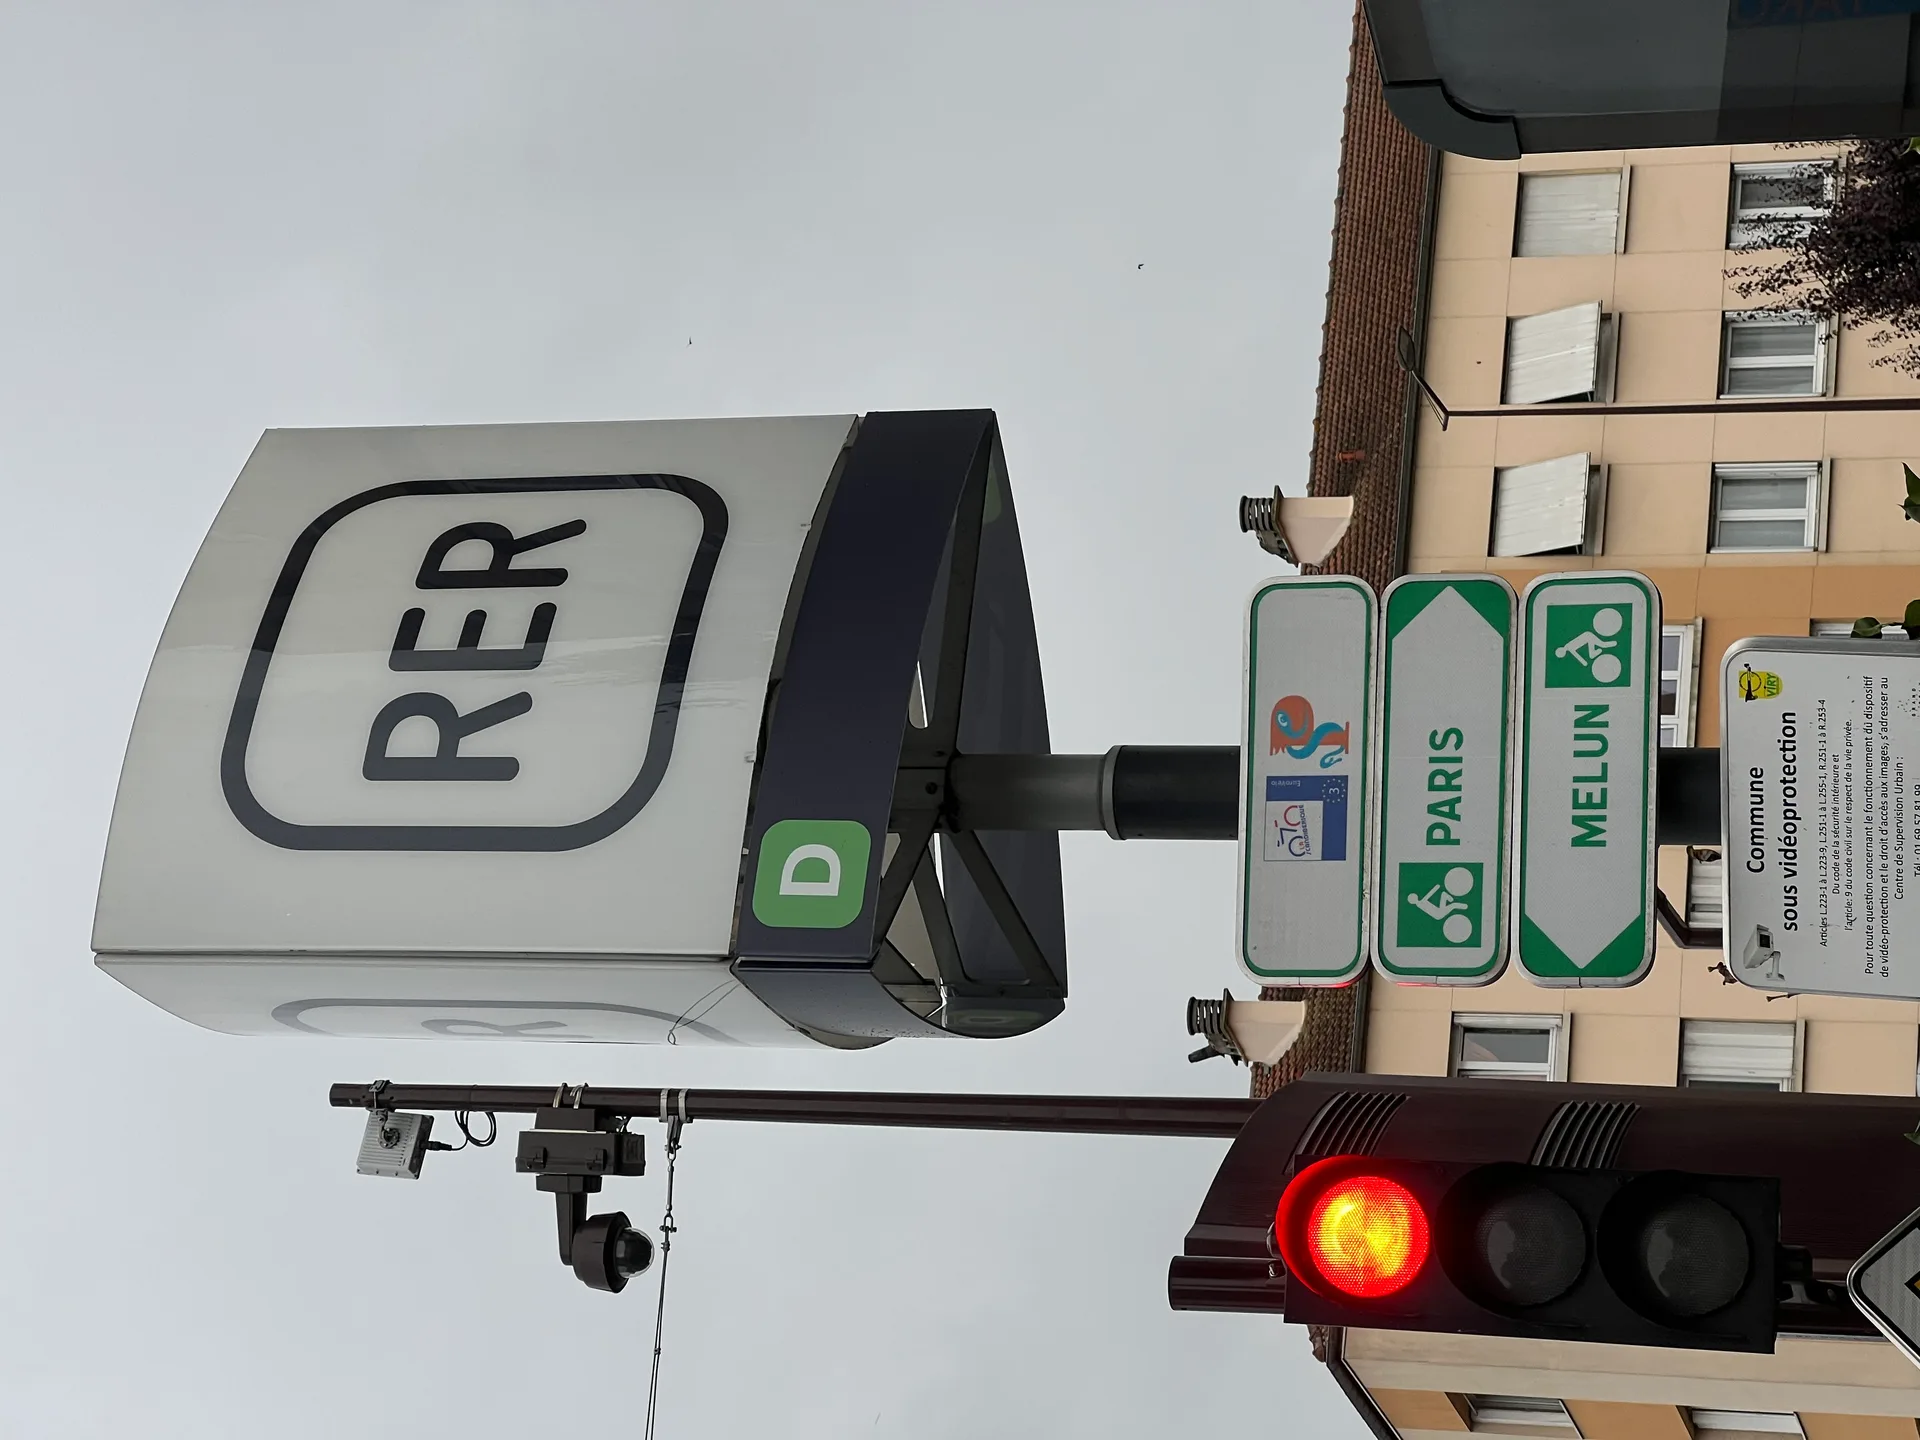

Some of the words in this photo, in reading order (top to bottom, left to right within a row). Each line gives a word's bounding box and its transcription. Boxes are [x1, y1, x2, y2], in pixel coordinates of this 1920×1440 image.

[361, 519, 587, 782] RER
[1863, 675, 1875, 720] dispositif
[1881, 677, 1888, 689] au
[1817, 699, 1826, 730] R.253-4
[1862, 722, 1873, 734] du
[1878, 691, 1888, 740] s’adresser
[1843, 719, 1854, 747] privée.
[1818, 740, 1827, 770] R.251-1
[1832, 754, 1839, 763] et
[1844, 749, 1852, 761] vie
[1878, 742, 1891, 779] images,
[1425, 727, 1464, 846] PARIS
[1571, 704, 1610, 847] MELUN
[1818, 773, 1828, 804] L.255-1,
[1831, 764, 1839, 805] intérieure
[1844, 772, 1852, 782] de
[1863, 737, 1873, 813] fonctionnement
[1893, 762, 1904, 794] Urbain
[1329, 787, 1340, 795] 3
[1777, 712, 1802, 879] vidéoprotection
[1845, 784, 1854, 814] respect
[1746, 767, 1765, 873] Commune
[1819, 814, 1827, 843] L.251-1
[1831, 806, 1840, 839] sécurité
[1844, 816, 1852, 824] le
[1863, 815, 1873, 824] le
[1878, 800, 1888, 835] d’accès
[1894, 797, 1906, 852] Supervision
[1819, 845, 1828, 877] L.223-9,
[1831, 849, 1840, 860] de
[1844, 840, 1853, 856] civil
[1864, 826, 1873, 880] concernant
[1878, 838, 1888, 861] droit
[1893, 854, 1904, 866] de
[779, 843, 841, 897] D
[1831, 862, 1840, 882] code
[1844, 858, 1853, 877] code
[1878, 863, 1889, 871] le
[1880, 874, 1889, 884] et
[1832, 883, 1840, 894] Du
[1844, 879, 1853, 890] du
[1894, 868, 1904, 900] Centre
[1783, 885, 1798, 931] sous
[1819, 886, 1828, 915] L.223-1
[1844, 898, 1853, 931] l’article:
[1864, 882, 1876, 923] question
[1819, 917, 1828, 947] Articles
[1865, 925, 1874, 950] toute
[1878, 886, 1891, 964] vidéo-protection
[1864, 952, 1874, 974] Pour
[1879, 966, 1889, 978] de
